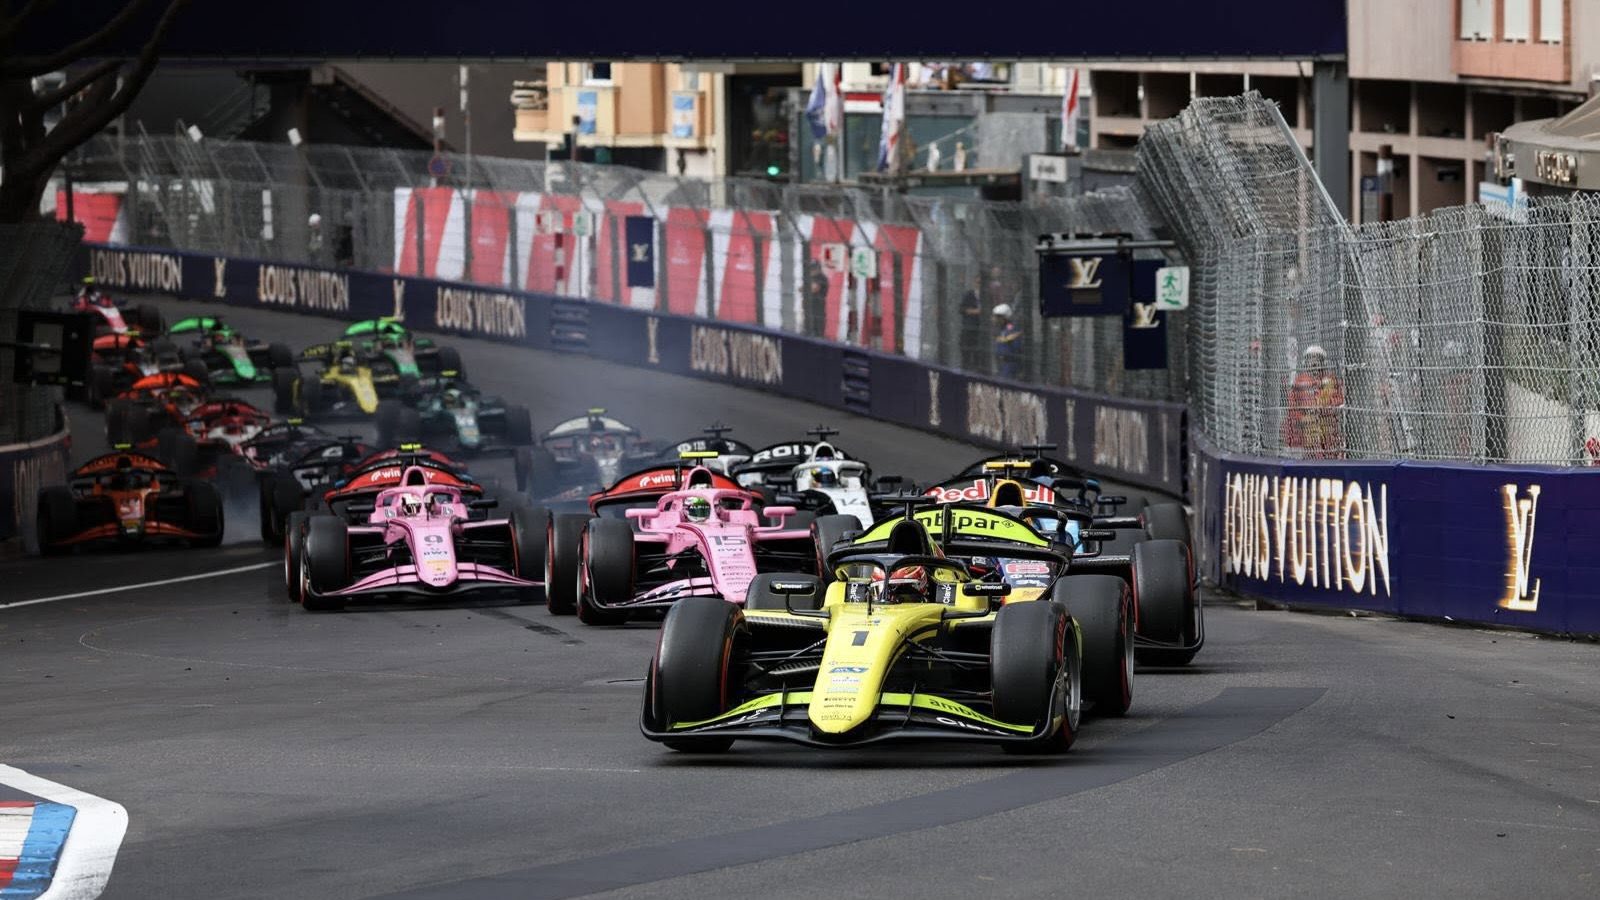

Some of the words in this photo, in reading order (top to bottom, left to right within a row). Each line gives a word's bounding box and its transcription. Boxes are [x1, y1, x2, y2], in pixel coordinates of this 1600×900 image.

[90, 250, 126, 287] LOUIS
[128, 252, 182, 292] VUITTON
[1066, 257, 1102, 288] LV
[259, 264, 296, 306] LOUIS
[298, 269, 349, 312] VUITTON
[437, 286, 472, 331] LOUIS
[473, 291, 526, 338] VUITTON
[925, 478, 987, 504] Red
[709, 535, 747, 546] 15
[1223, 471, 1270, 581] LOUIS
[1273, 475, 1390, 598] VUITTON
[943, 585, 952, 604] Claro
[851, 631, 870, 647] 1
